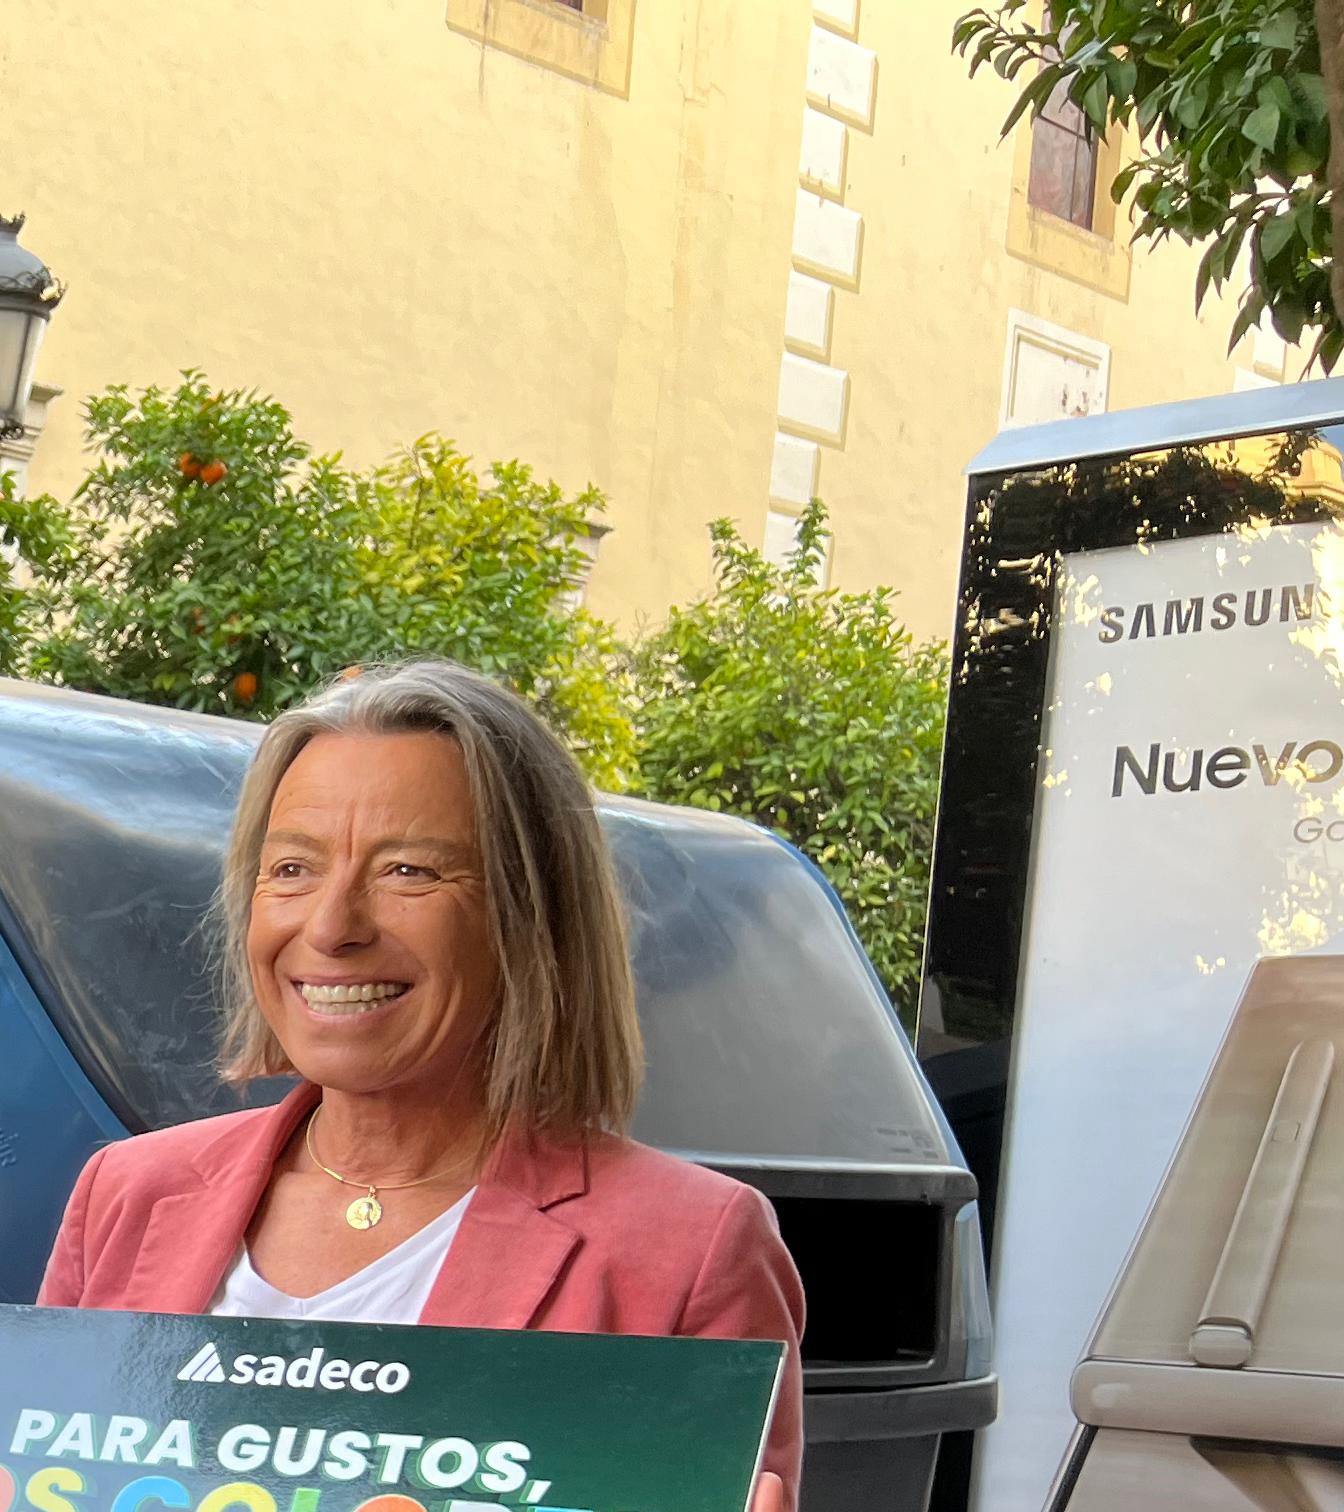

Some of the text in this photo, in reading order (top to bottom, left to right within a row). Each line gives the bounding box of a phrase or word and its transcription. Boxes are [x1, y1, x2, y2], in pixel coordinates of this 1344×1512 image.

[1099, 582, 1324, 645] SAMSUN
[1112, 739, 1344, 798] Nuevo
[229, 1347, 411, 1395] sadeco
[9, 1408, 553, 1502] PARA GUSTOS,
